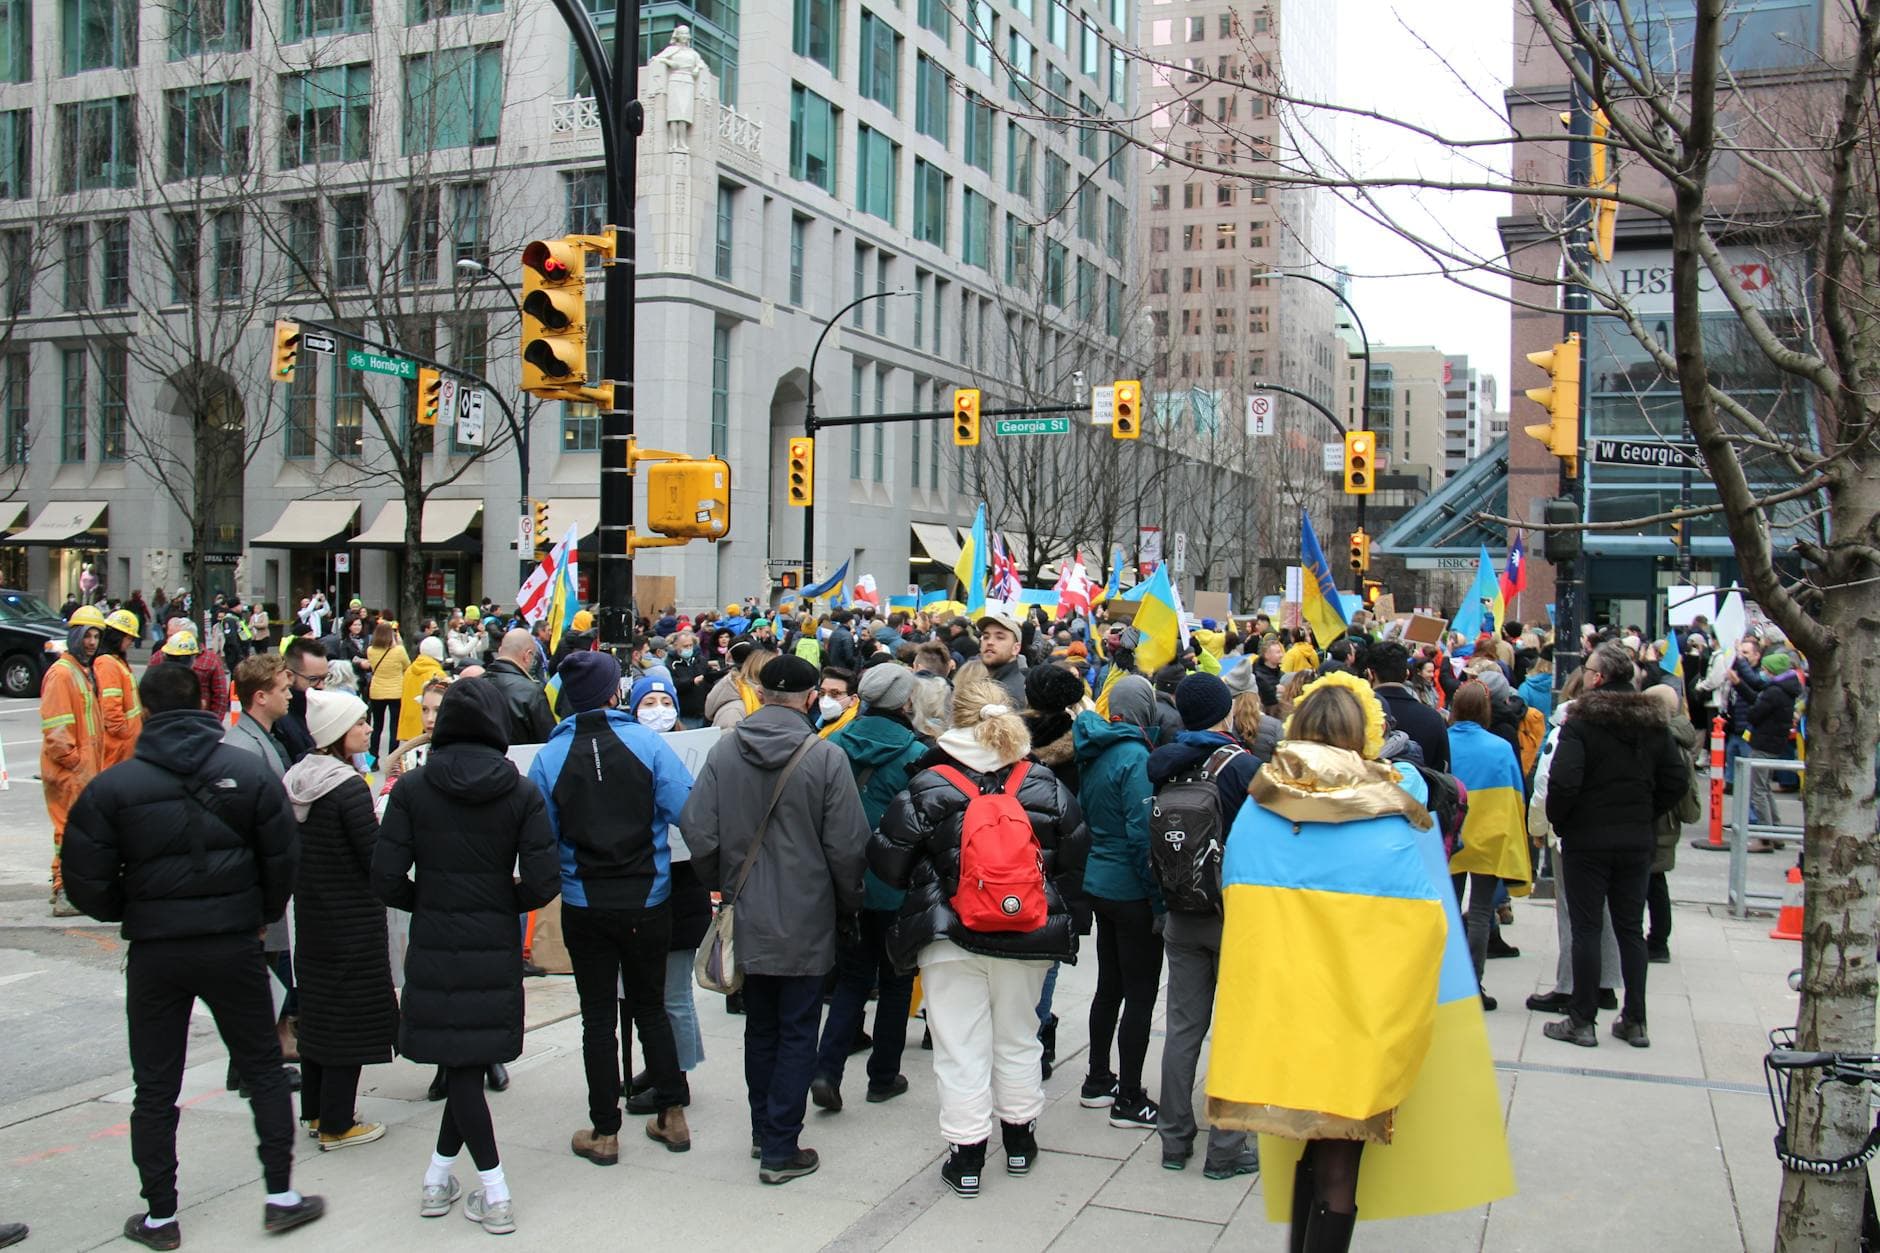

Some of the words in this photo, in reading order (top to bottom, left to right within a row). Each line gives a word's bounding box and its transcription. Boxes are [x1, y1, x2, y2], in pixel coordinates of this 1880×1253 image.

[1619, 265, 1716, 295] HSC
[370, 356, 399, 374] Hornby
[399, 361, 409, 374] St
[1001, 421, 1046, 433] Georgia
[1050, 420, 1064, 430] St
[1601, 442, 1616, 459] W
[1621, 443, 1684, 466] Georgia
[1437, 559, 1468, 568] HSBC
[1711, 779, 1722, 820] PCL
[1138, 1105, 1157, 1121] N
